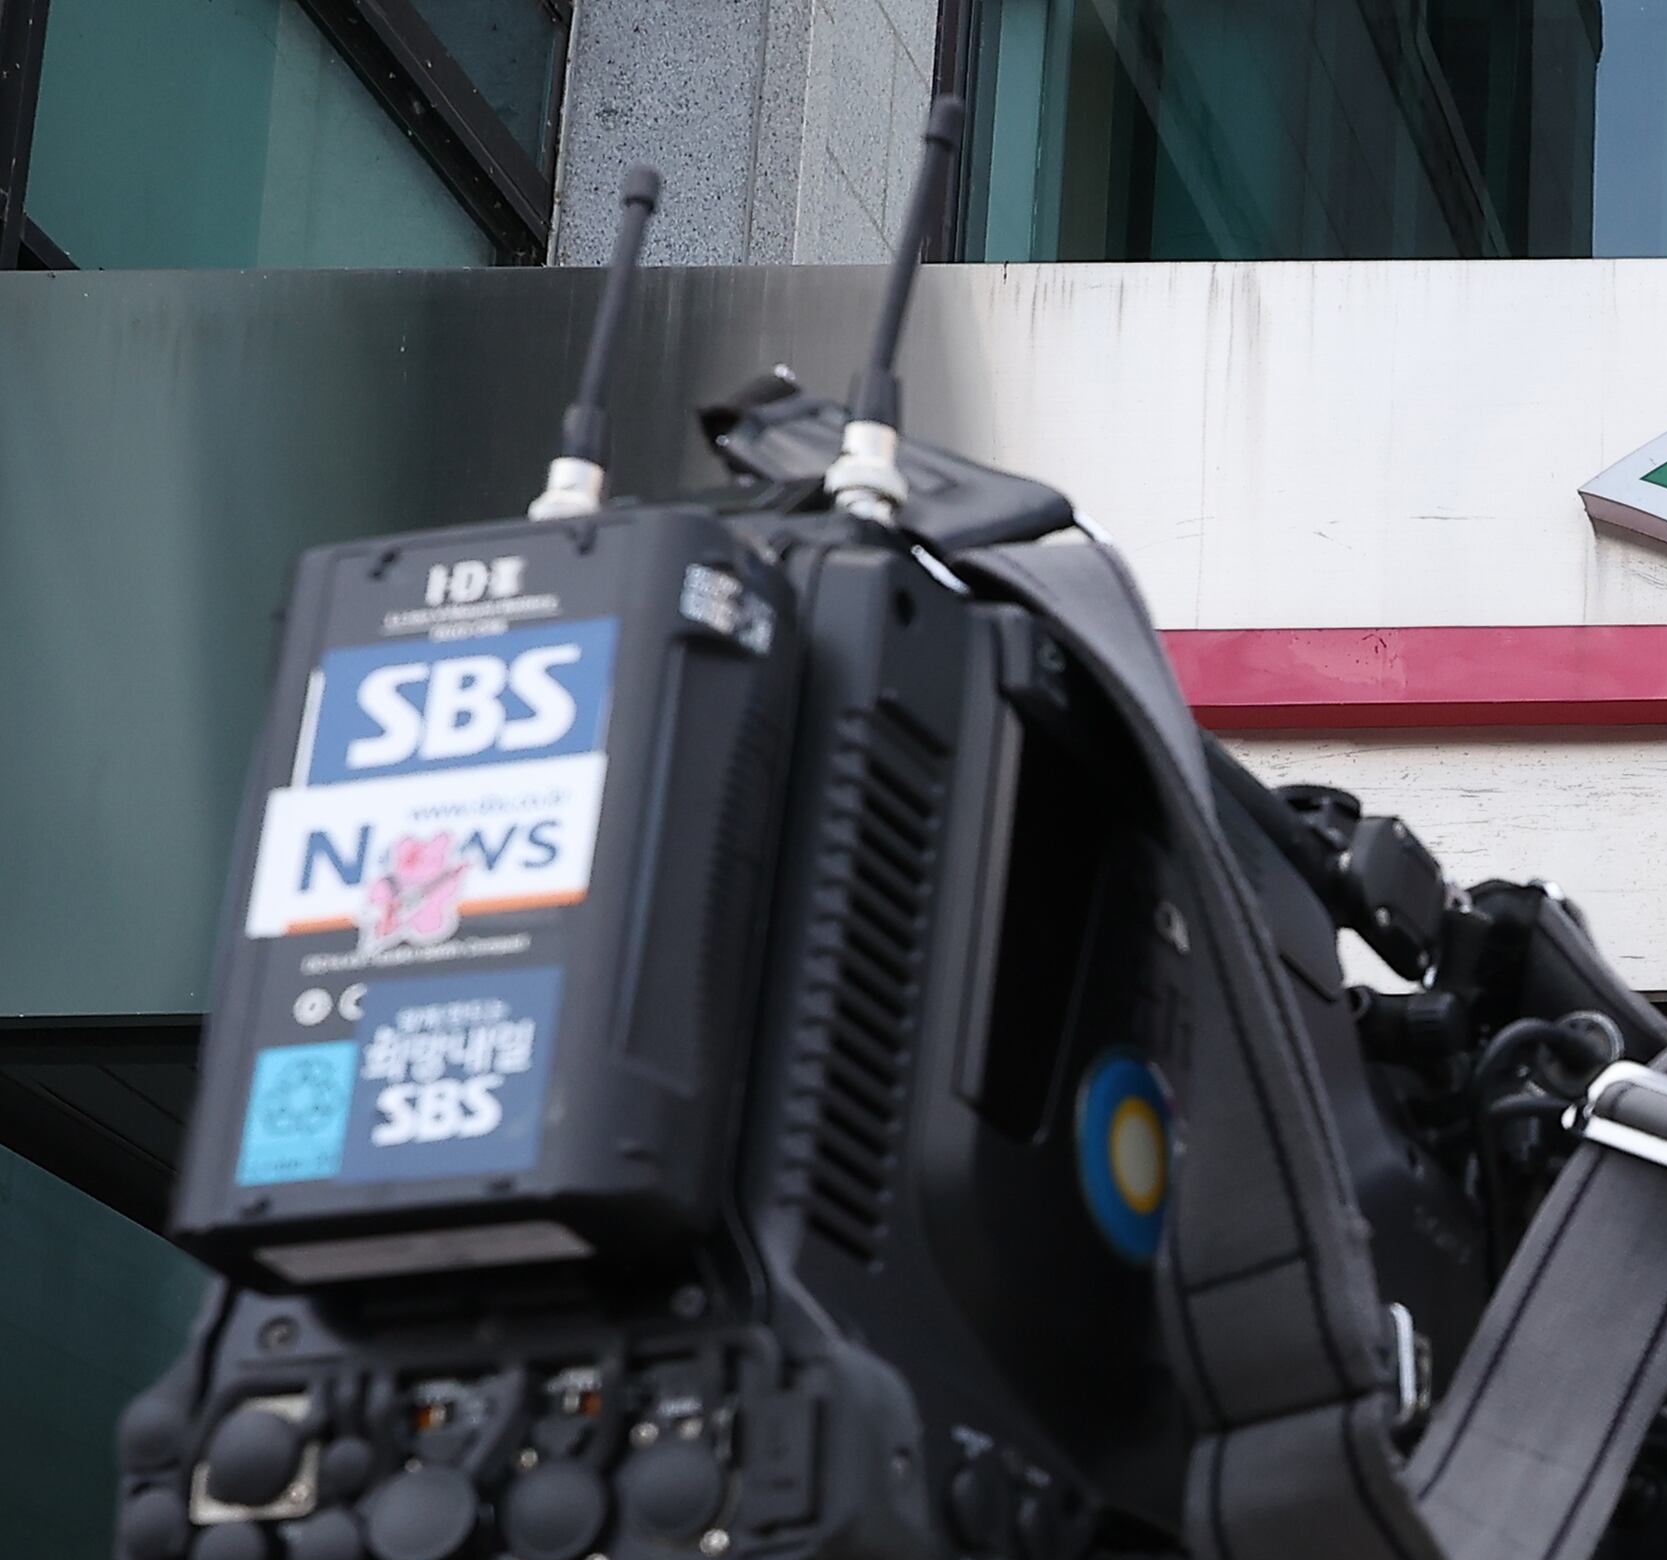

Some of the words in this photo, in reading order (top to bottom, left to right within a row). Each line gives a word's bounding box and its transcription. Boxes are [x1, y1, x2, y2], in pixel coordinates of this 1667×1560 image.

[346, 644, 581, 769] SBS
[298, 822, 561, 894] Nws
[371, 1074, 504, 1147] SBS
